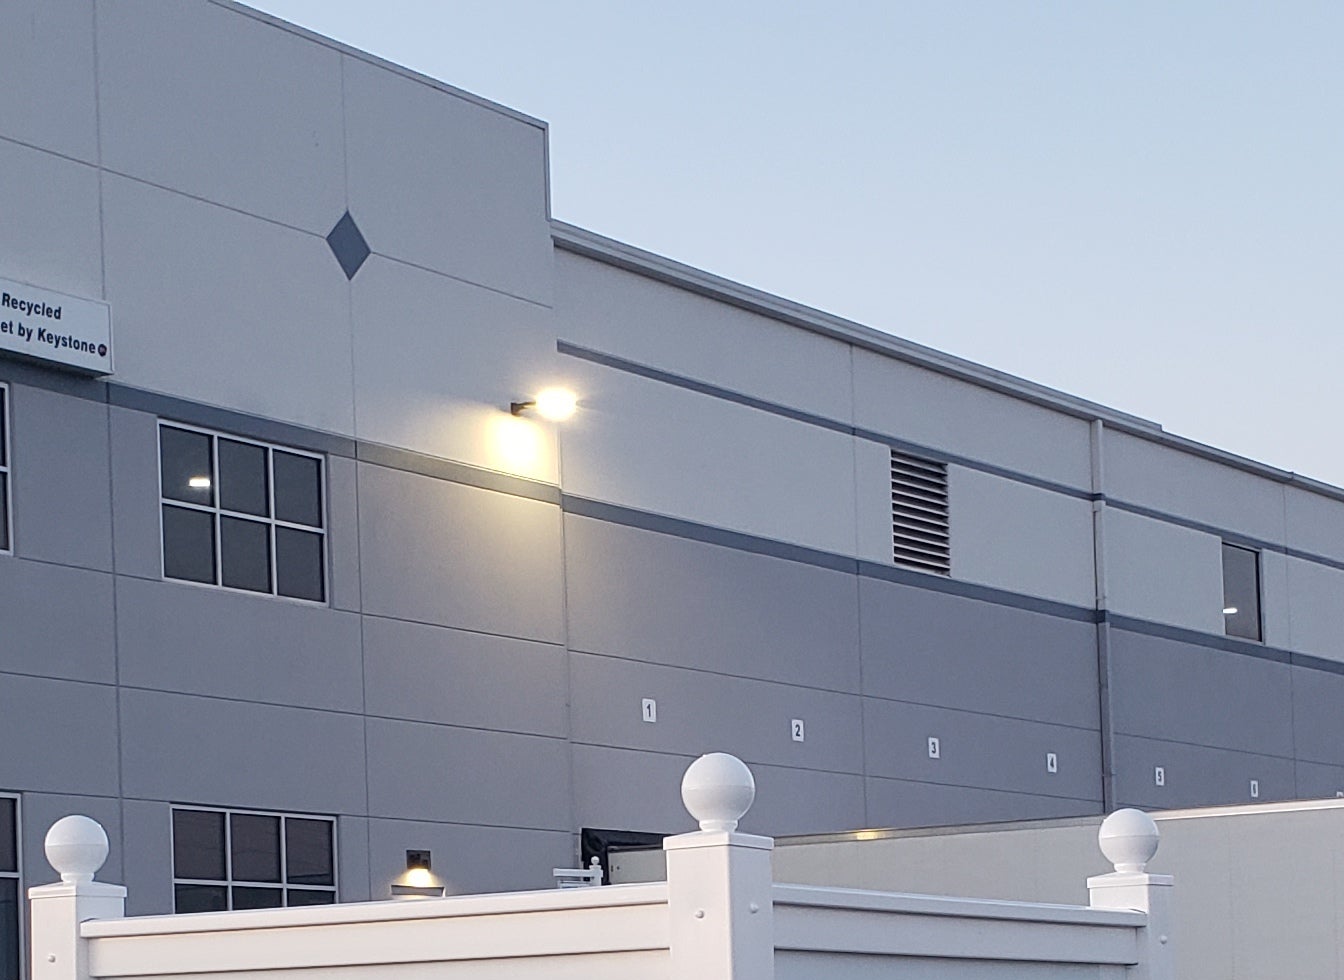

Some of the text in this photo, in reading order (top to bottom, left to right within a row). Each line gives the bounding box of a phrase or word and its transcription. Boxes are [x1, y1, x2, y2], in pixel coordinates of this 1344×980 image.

[2, 292, 62, 320] Recycled
[18, 321, 33, 342] by
[37, 327, 96, 354] Keystone
